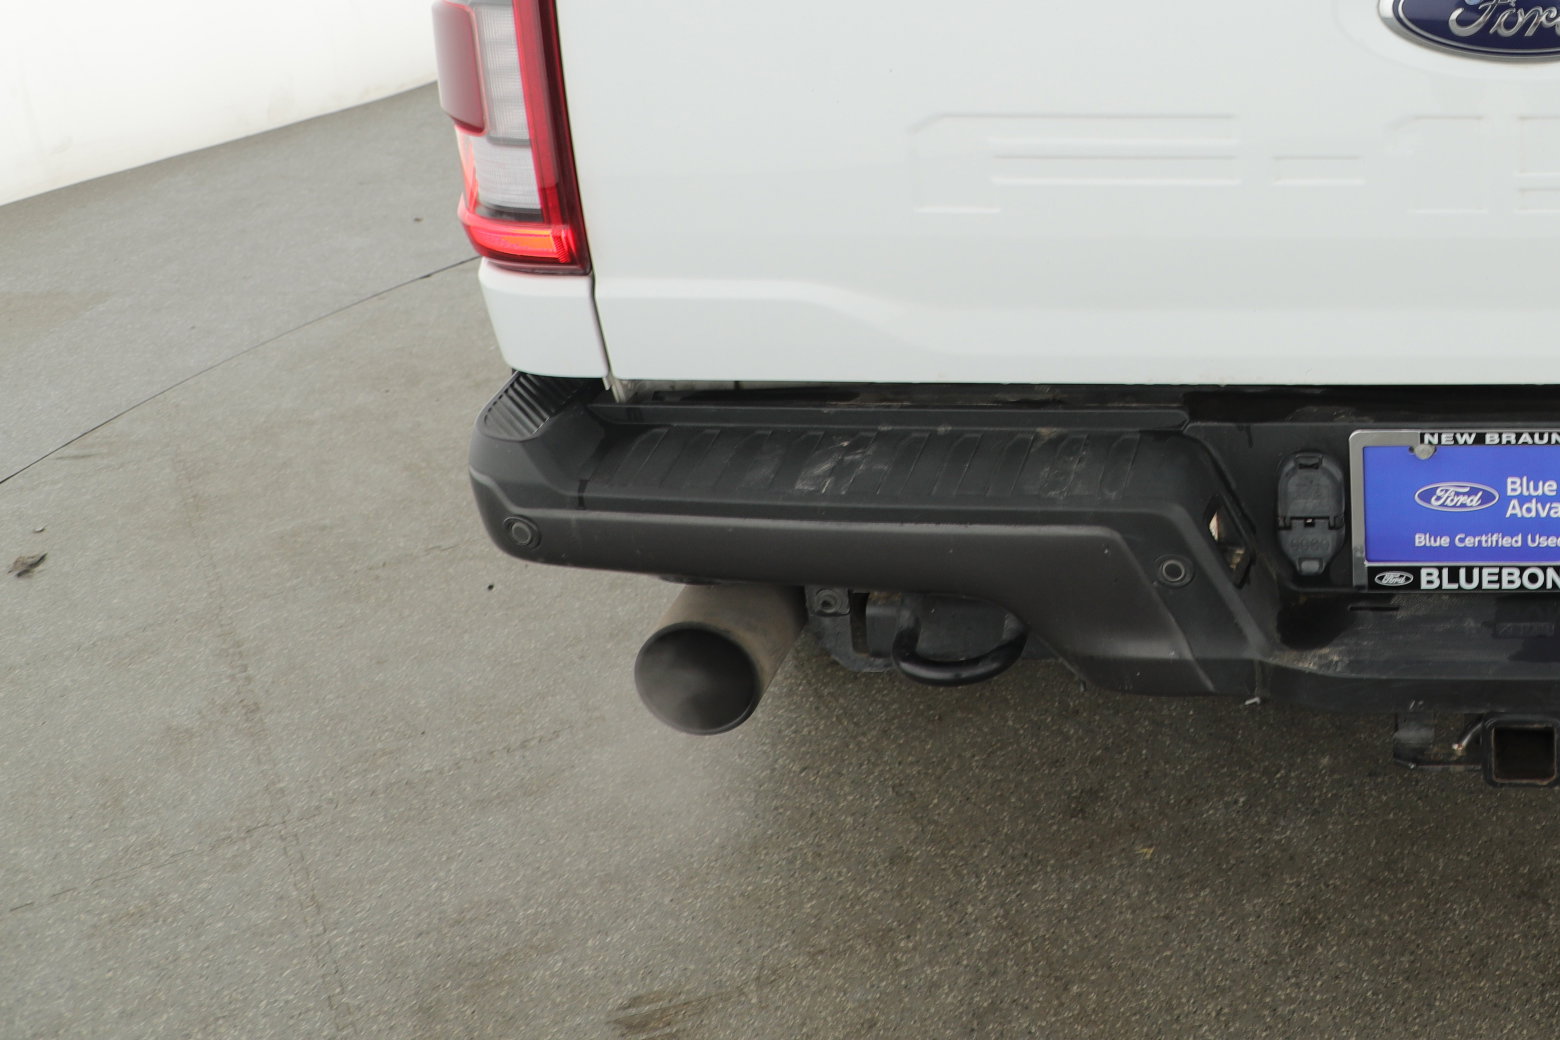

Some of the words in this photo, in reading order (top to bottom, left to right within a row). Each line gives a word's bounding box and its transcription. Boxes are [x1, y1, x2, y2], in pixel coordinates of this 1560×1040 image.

[1423, 432, 1476, 445] NEW
[1505, 476, 1558, 496] Blue
[1430, 484, 1483, 508] Ford
[1414, 533, 1450, 548] Blue
[1455, 532, 1522, 548] Certified
